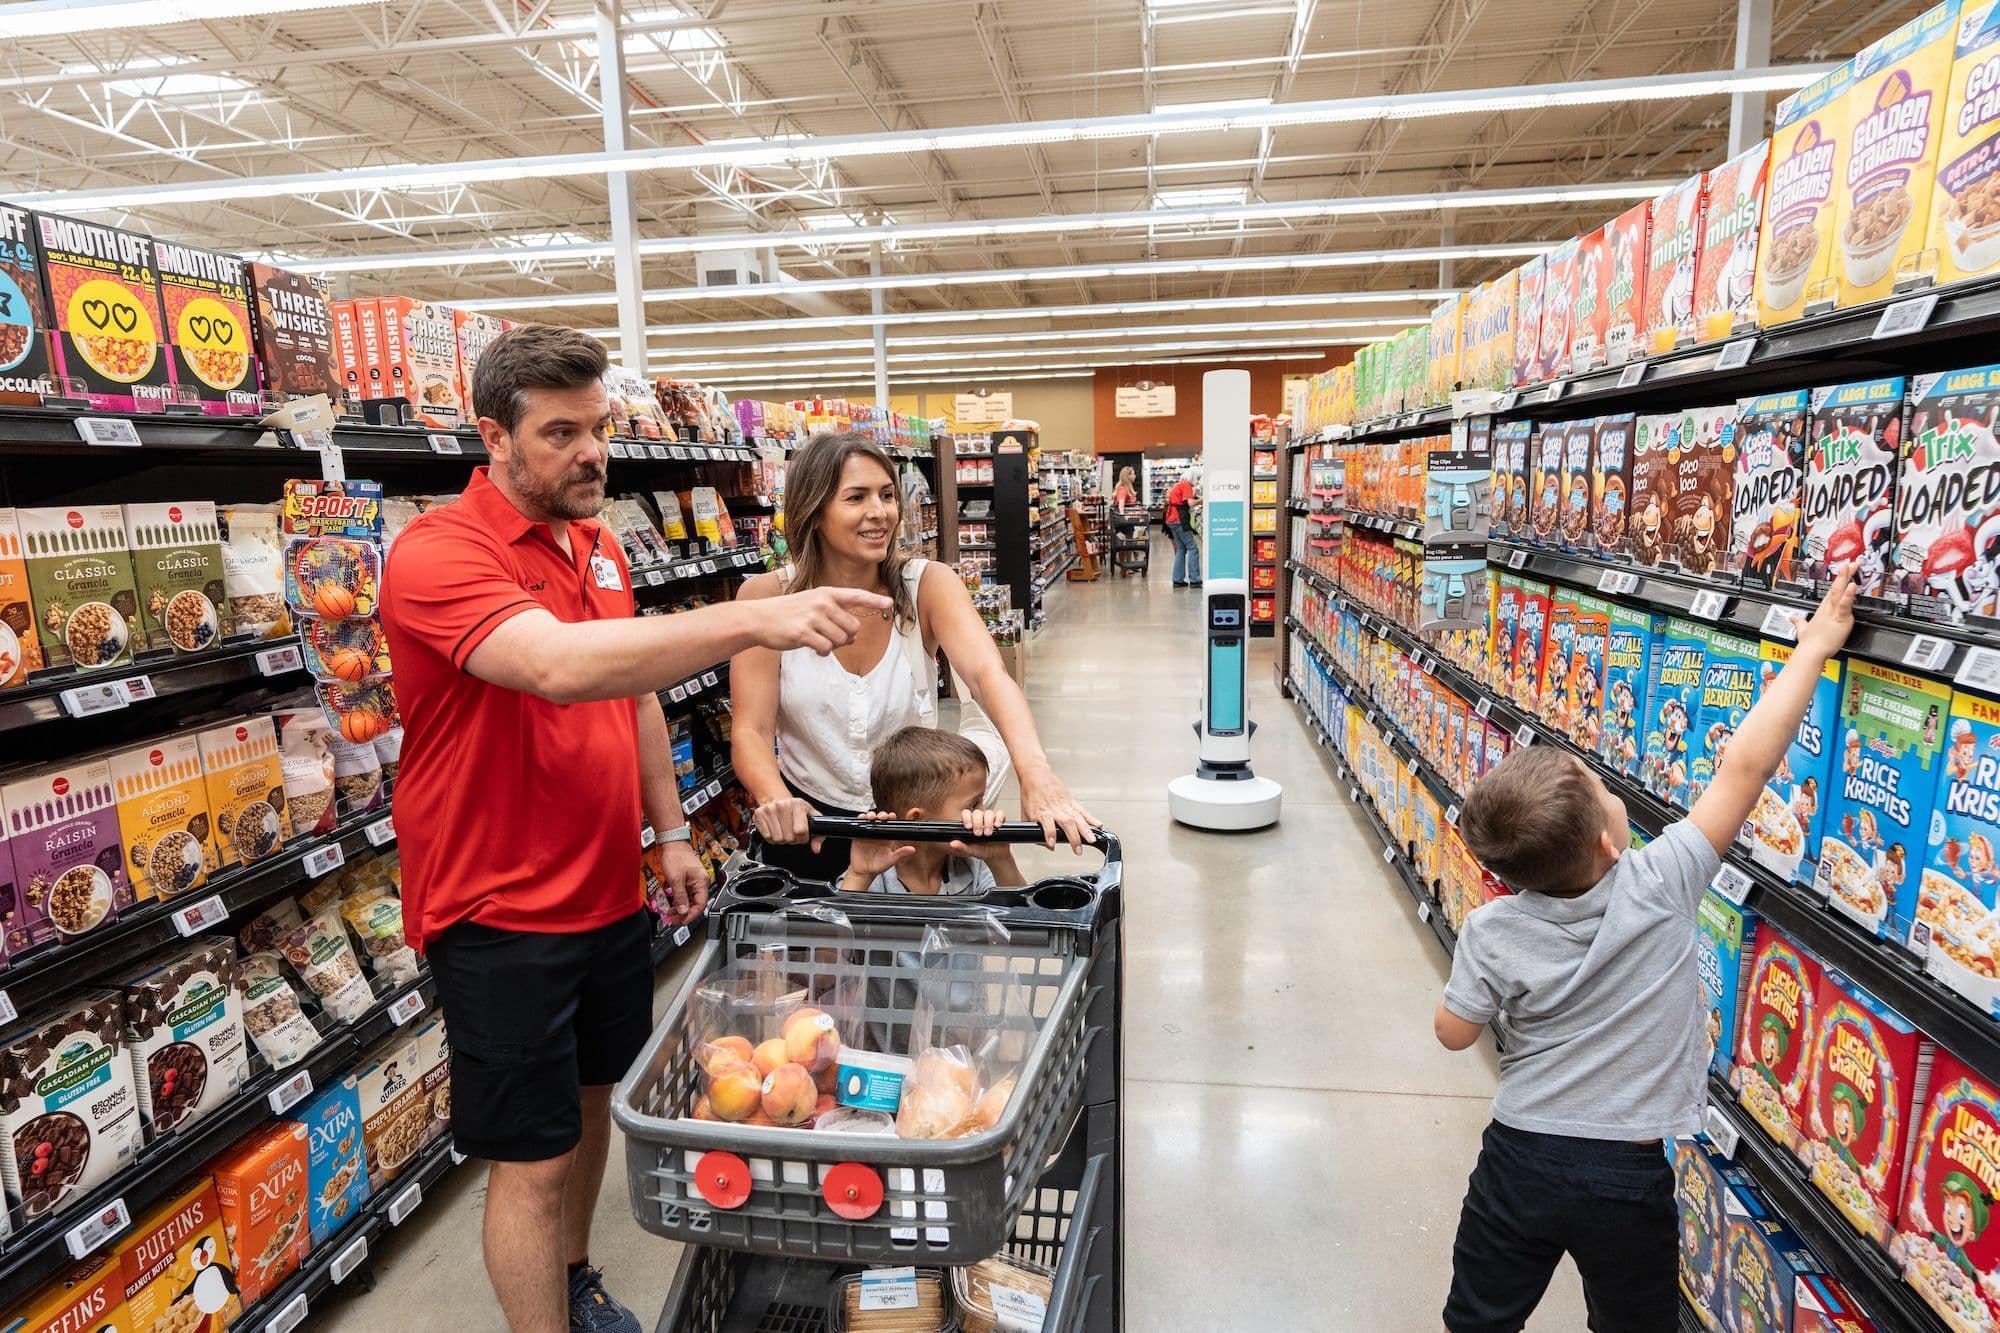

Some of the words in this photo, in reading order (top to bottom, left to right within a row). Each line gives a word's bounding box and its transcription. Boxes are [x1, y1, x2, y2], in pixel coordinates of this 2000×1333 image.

[1706, 196, 1755, 250] minis
[52, 219, 119, 261] MOUTH
[118, 234, 150, 267] OFF
[1652, 222, 1692, 271] minis
[47, 251, 68, 262] 100%
[69, 255, 93, 267] PLANT
[95, 259, 117, 270] BASED
[165, 244, 218, 281] MOUTH
[216, 254, 243, 286] OFF
[178, 276, 198, 287] PLANT
[198, 280, 217, 290] BASED
[268, 288, 325, 319] THREE
[272, 308, 328, 336] WISHES
[411, 317, 451, 343] THREE
[338, 312, 357, 369] WISHES
[362, 309, 379, 367] WISHES
[385, 307, 401, 365] WISHES
[413, 336, 453, 358] WISHES
[134, 386, 173, 400] FRUITY
[980, 388, 986, 397] 4
[1142, 381, 1149, 390] 3
[1838, 386, 1868, 403] LARGE
[1869, 383, 1893, 399] SIZE
[1946, 373, 1985, 392] LARGE
[230, 391, 263, 405] FRUITY
[1755, 397, 1778, 412] LARGE
[1780, 394, 1798, 409] SIZE
[1820, 428, 1863, 472] Trix
[1920, 420, 1975, 470] Trix
[1633, 461, 1650, 477] coco
[1679, 459, 1699, 476] coco
[1633, 477, 1648, 492] loco
[1679, 475, 1698, 494] loco
[1734, 467, 1794, 516] LOADED
[1806, 464, 1886, 522] LOADED
[1900, 462, 2000, 529] LOADED
[302, 496, 370, 518] SPORT
[54, 565, 117, 581] CLASSIC
[157, 556, 209, 571] CLASSIC
[168, 570, 203, 581] Granola
[67, 578, 109, 592] Granola
[1580, 596, 1593, 608] LARGE
[1594, 600, 1608, 613] SIZE
[1612, 607, 1631, 622] LARGE
[1631, 612, 1646, 626] SIZE
[1520, 610, 1545, 631] CRUNCH
[1670, 620, 1692, 636] LARGE
[1693, 626, 1708, 640] SIZE
[1575, 634, 1604, 653] CRUNCH
[1626, 637, 1642, 652] ALL
[1711, 634, 1738, 652] LARGE
[1739, 643, 1759, 658] SIZE
[1772, 648, 1790, 661] FAM
[1608, 653, 1641, 669] BERRIES
[1682, 652, 1703, 669] ALL
[1660, 668, 1700, 687] BERRIES
[1729, 672, 1754, 690] ALL
[1871, 666, 1902, 685] FAMILY
[1903, 676, 1923, 689] SIZE
[1703, 687, 1751, 711] BERRIES
[1864, 692, 1883, 706] FREE
[228, 767, 271, 790] ALMOND
[1861, 757, 1900, 793] RICE
[236, 780, 267, 796] Granola
[141, 794, 190, 818] ALMOND
[1843, 776, 1911, 828] KRISPIES
[150, 807, 185, 825] Granola
[45, 825, 97, 852] RAISIN
[51, 840, 94, 861] Granola
[1698, 943, 1718, 973] RICE
[1699, 961, 1724, 998] ISPIES
[1768, 961, 1800, 1001] Lucky
[171, 999, 208, 1023] CASCADIAN
[209, 989, 225, 1003] FARM
[1760, 980, 1799, 1030] Charms
[184, 1020, 205, 1035] GLUTEN
[205, 1011, 217, 1024] FREE
[209, 1022, 237, 1046] BROWNIE
[1837, 1023, 1876, 1076] Lucky
[41, 1062, 89, 1092] CASCADIAN
[90, 1049, 111, 1069] FARM
[425, 1061, 448, 1085] SIMPLY
[1828, 1046, 1877, 1104] Charms
[58, 1086, 86, 1104] GLUTEN
[86, 1075, 101, 1091] FREE
[91, 1085, 128, 1115] BROWNIE
[380, 1078, 407, 1104] QUAKER
[94, 1095, 127, 1120] CRUNCH
[366, 1105, 392, 1134] SIMPLY
[392, 1082, 422, 1113] GRANOLA
[308, 1106, 356, 1155] EXTRA
[217, 1185, 238, 1197] EXTRA
[250, 1158, 304, 1213] EXTRA
[135, 1200, 204, 1272] PUFFINS
[126, 1273, 152, 1297] PEANUT
[151, 1252, 176, 1278] BUTTER
[41, 1285, 107, 1333] FFINS
